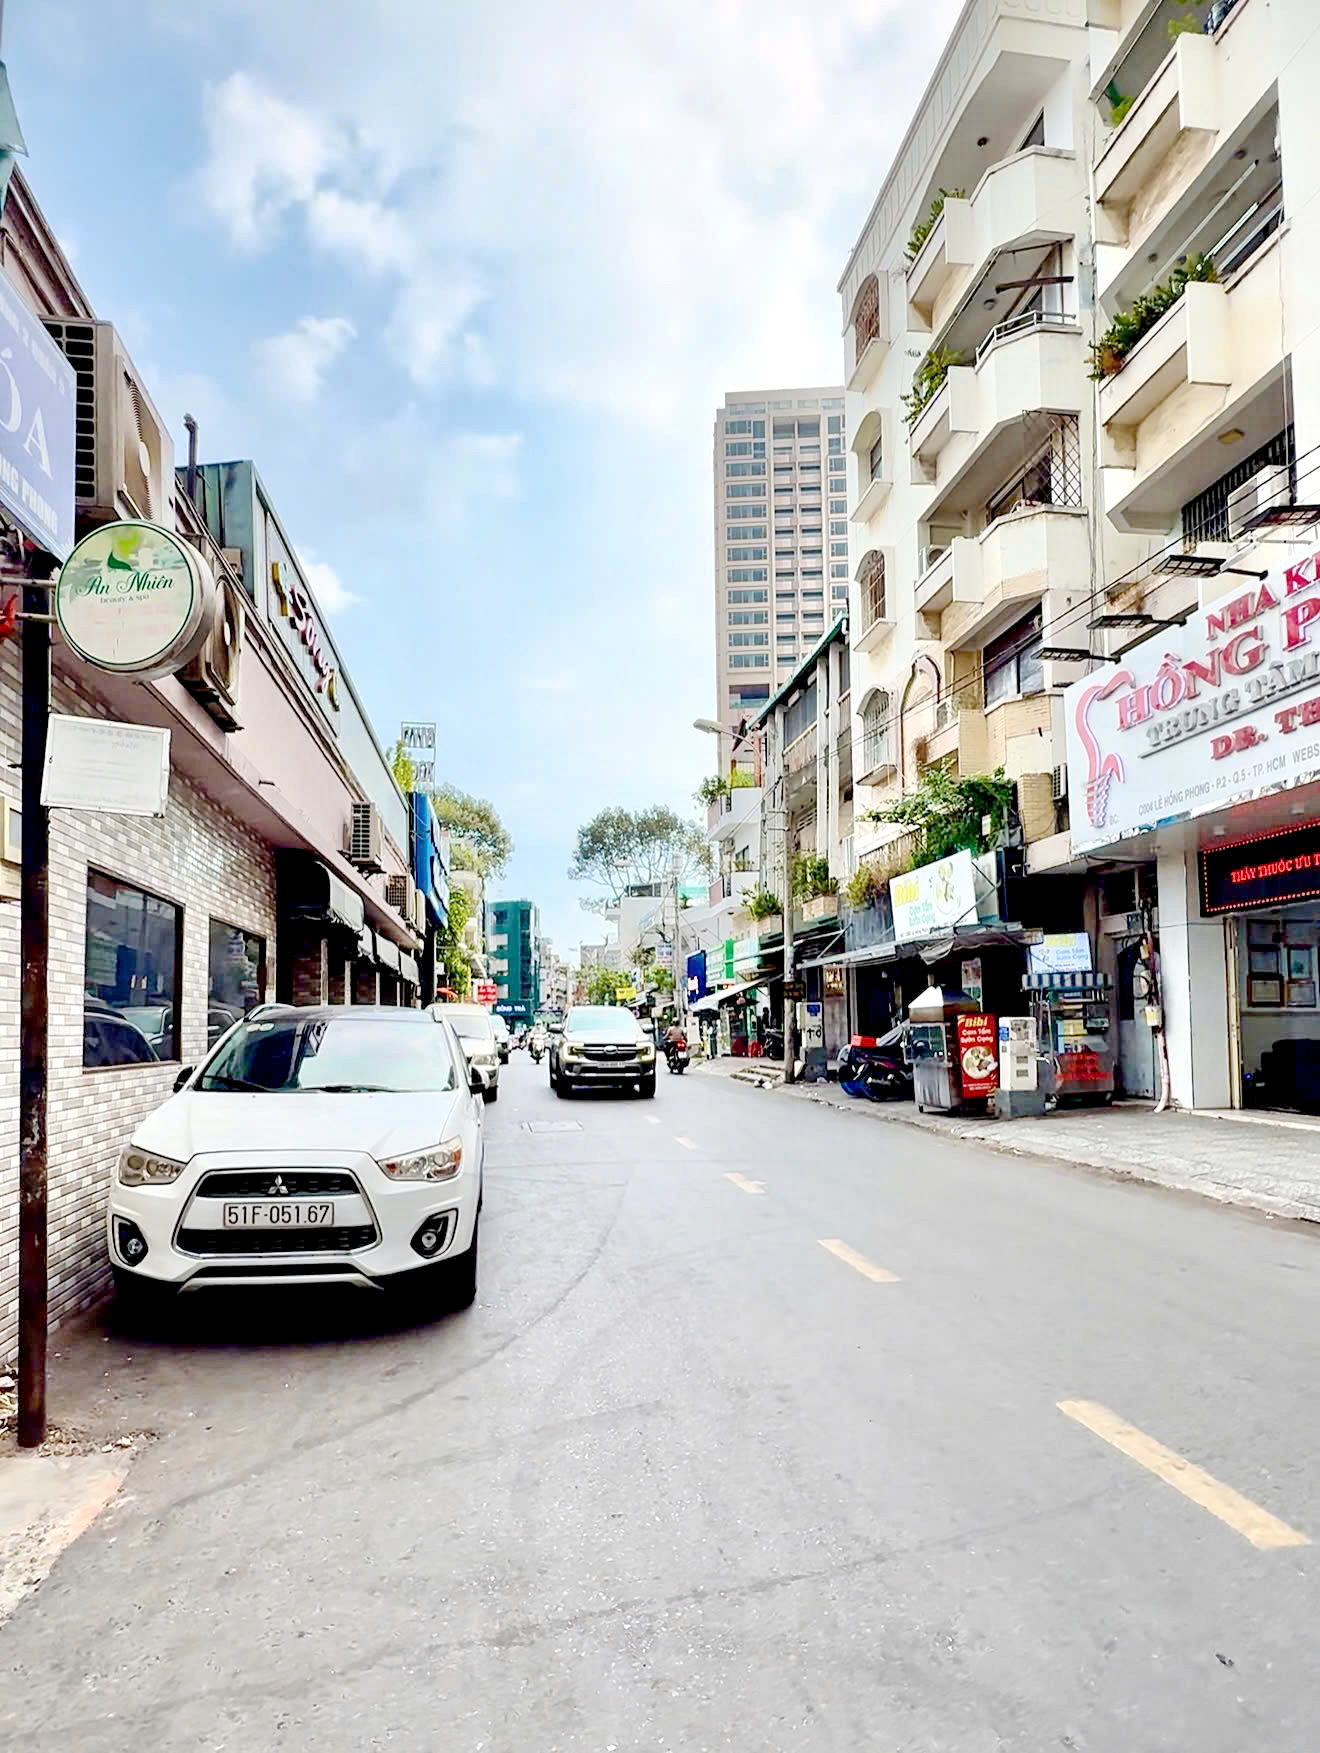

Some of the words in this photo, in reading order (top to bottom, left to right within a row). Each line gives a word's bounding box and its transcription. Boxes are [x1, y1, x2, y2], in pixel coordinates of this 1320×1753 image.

[75, 575, 110, 596] An
[116, 568, 174, 594] Nhiên
[1206, 584, 1280, 641] NHA
[1115, 625, 1271, 733] HỒNG
[1146, 688, 1241, 747] TRUNG
[1210, 725, 1268, 760] DR.
[1185, 781, 1211, 799] PHONG
[1266, 754, 1287, 774] HCM
[227, 1205, 331, 1225] 51F-051.67
